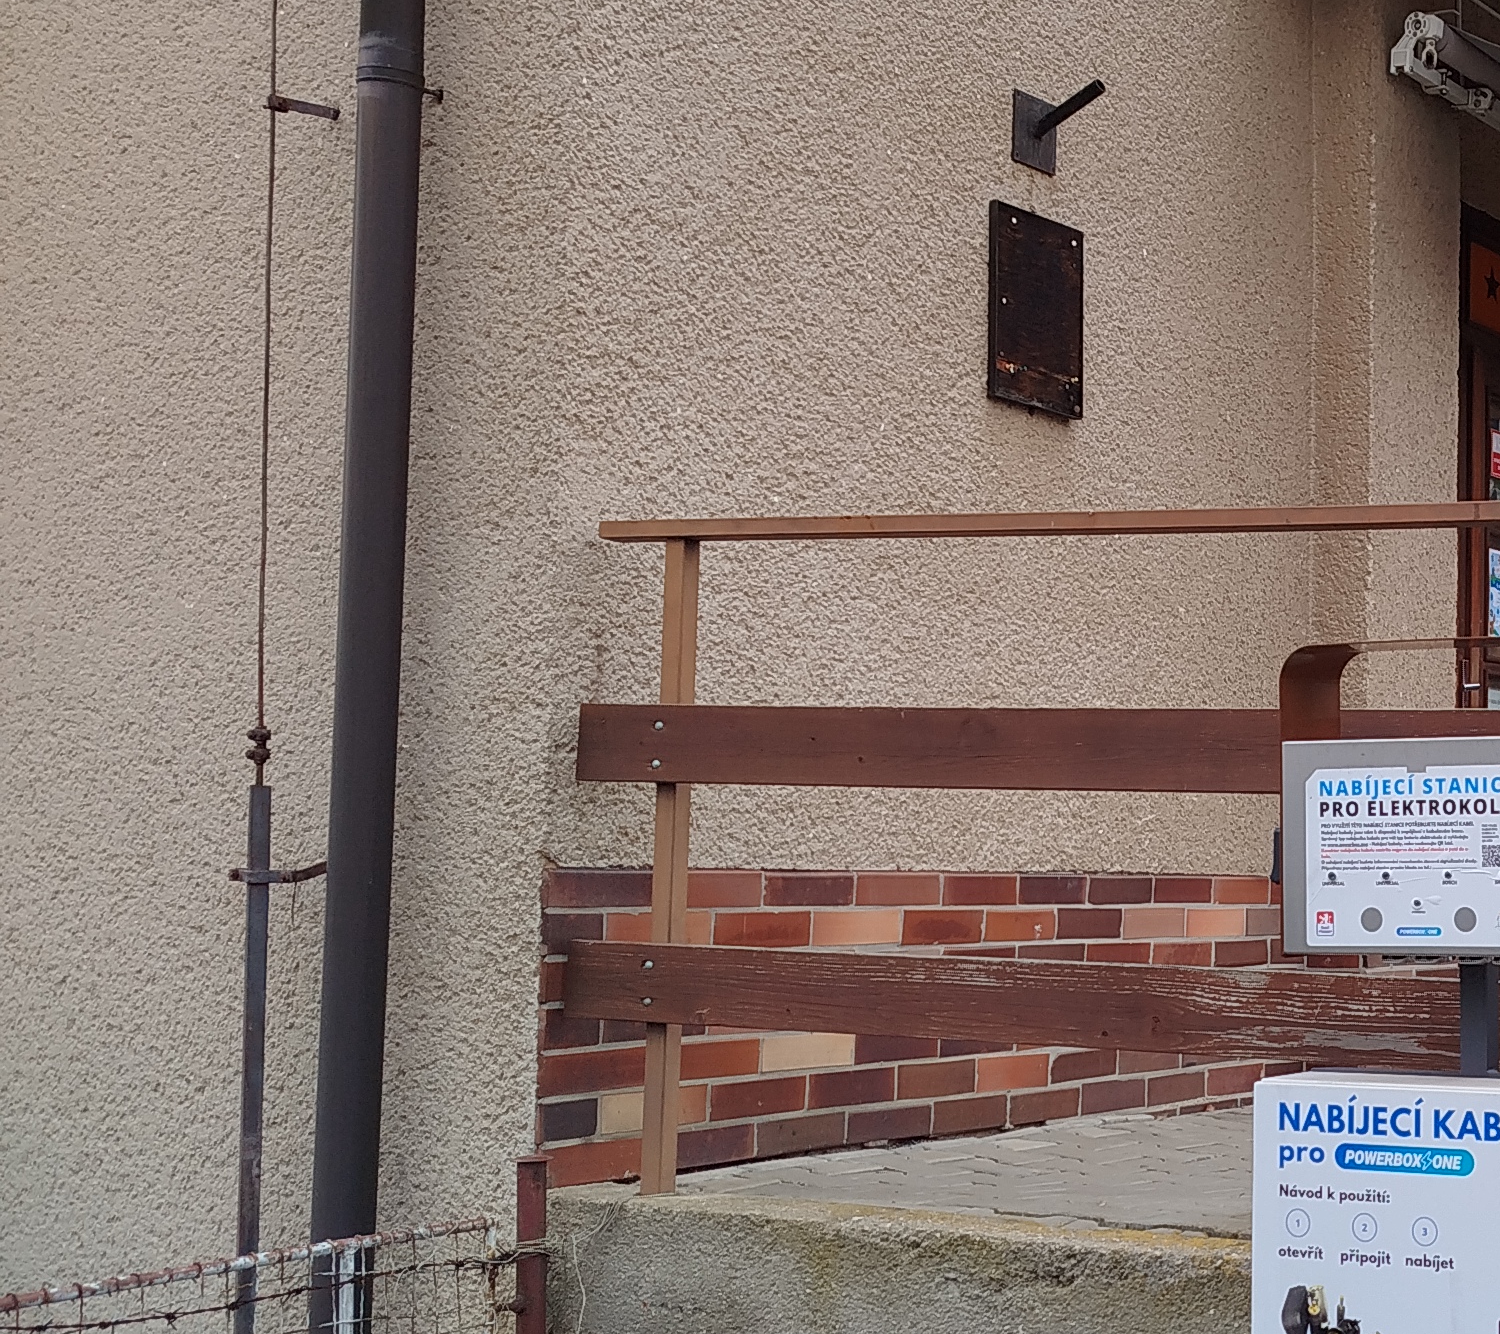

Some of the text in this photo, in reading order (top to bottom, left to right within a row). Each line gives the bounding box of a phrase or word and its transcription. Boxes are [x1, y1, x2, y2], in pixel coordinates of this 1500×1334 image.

[1319, 774, 1415, 800] NABÍJECÍ
[1320, 801, 1359, 817] PRO
[1278, 1094, 1424, 1138] NABÍJECÍ
[1279, 1145, 1325, 1169] pro
[1279, 1184, 1391, 1205] Návod k použití:
[1278, 1245, 1324, 1260] otevřít
[1340, 1249, 1391, 1268] připojit
[1405, 1254, 1455, 1272] nabíjet
